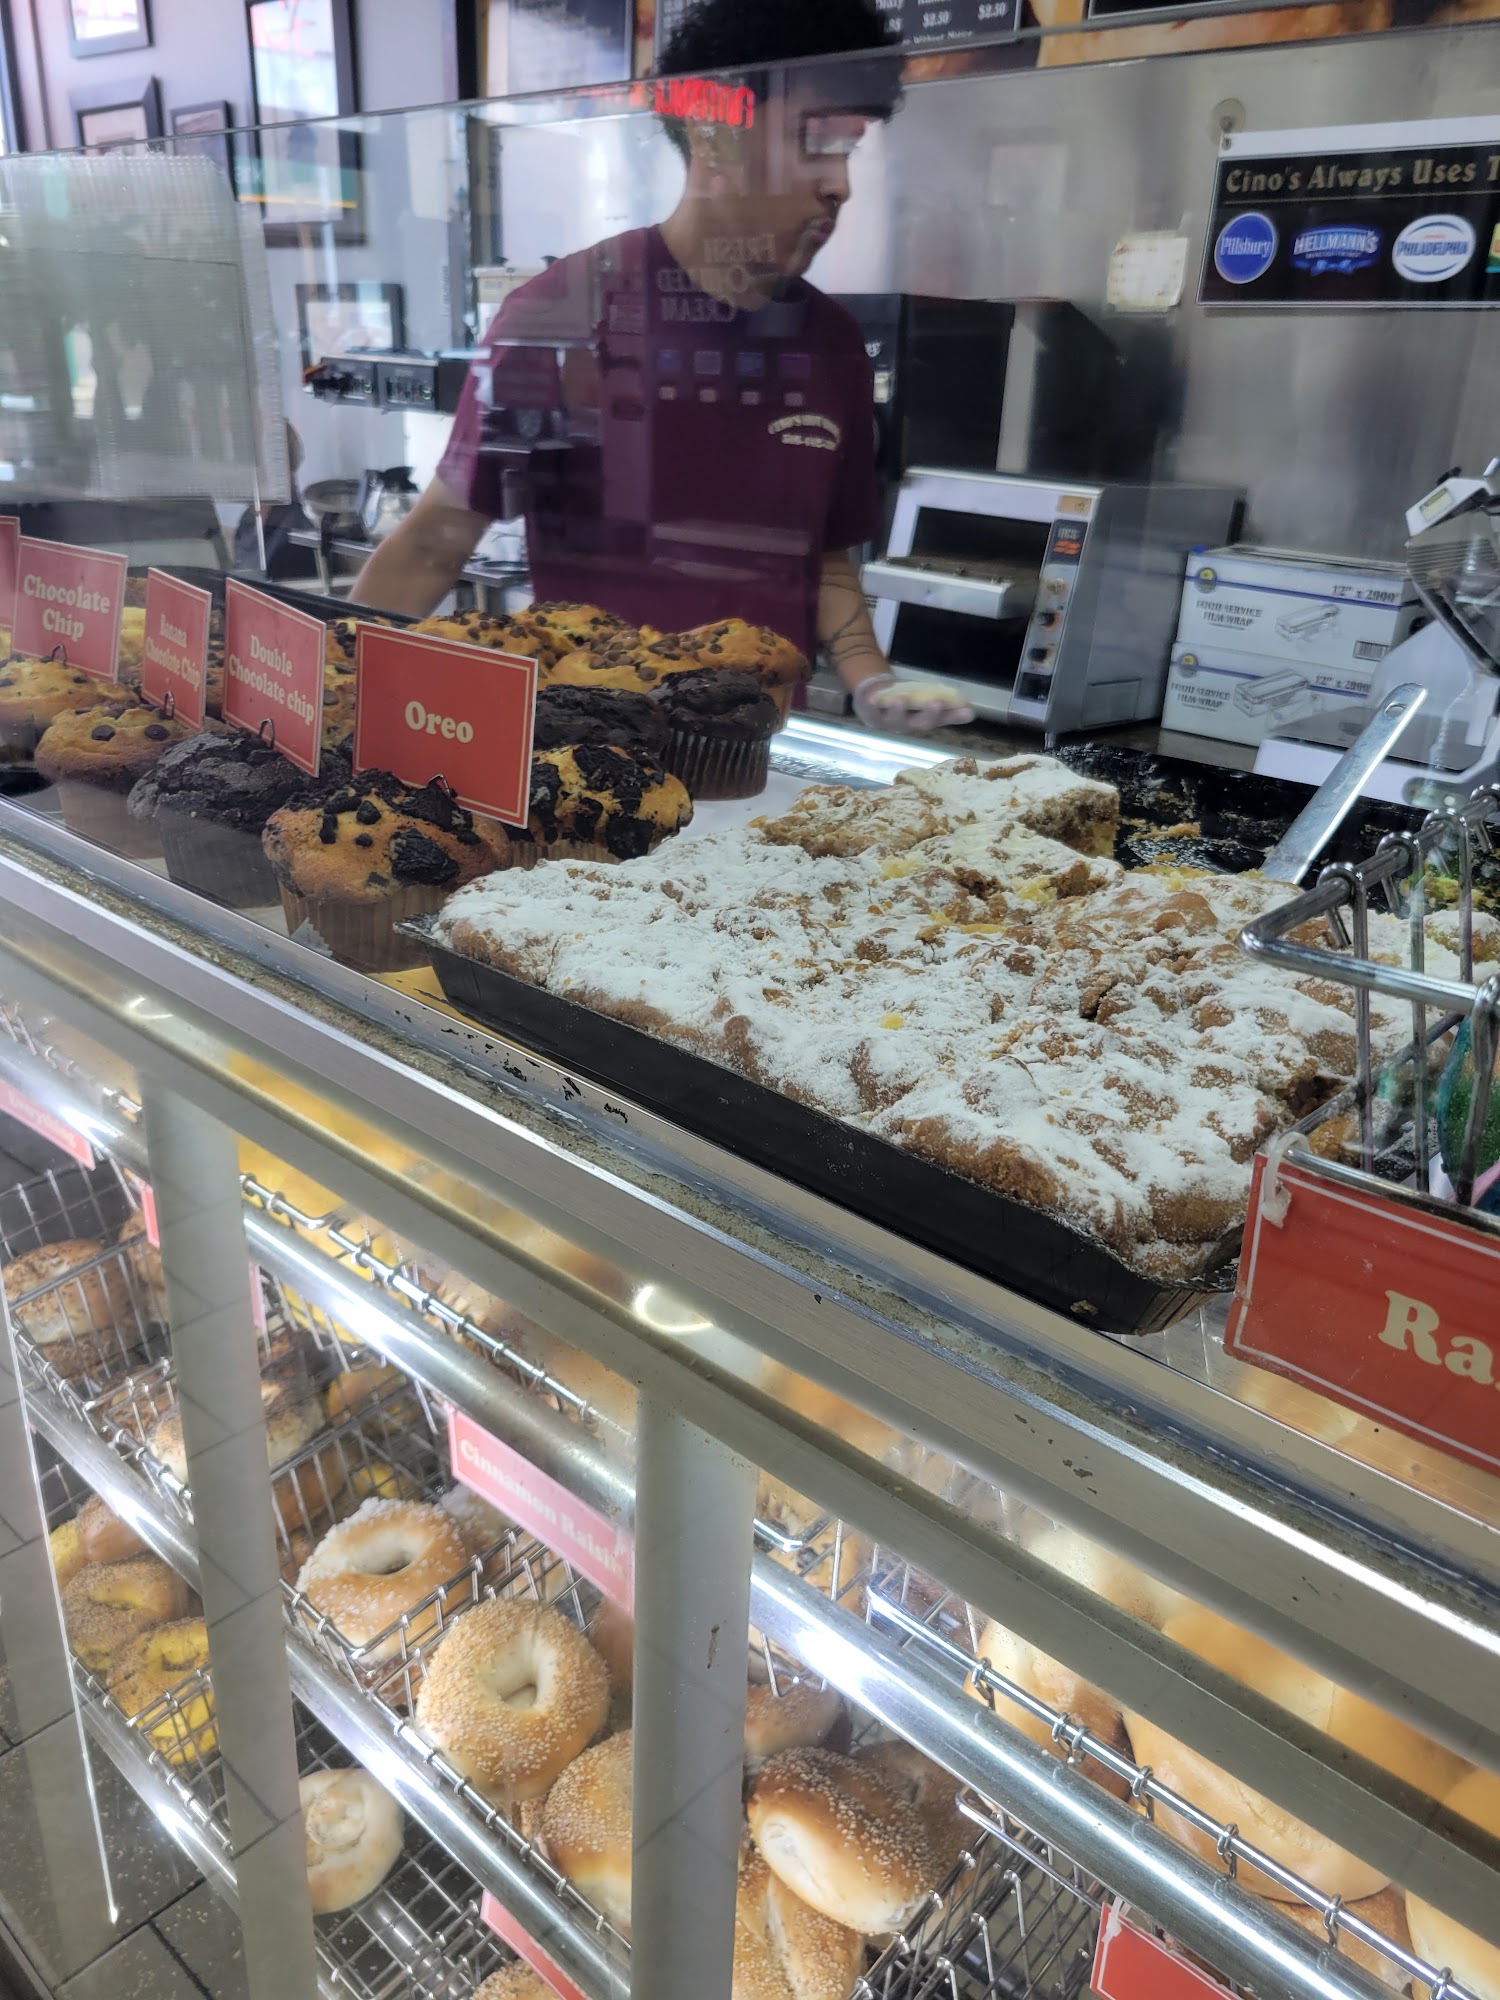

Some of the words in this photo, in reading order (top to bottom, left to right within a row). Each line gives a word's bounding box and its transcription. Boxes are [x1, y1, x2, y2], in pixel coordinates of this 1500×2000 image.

[1226, 166, 1301, 193] Cino's
[1307, 164, 1402, 192] Always
[1412, 159, 1476, 184] Uses
[1220, 236, 1273, 258] Pillsbury
[23, 573, 111, 614] Chocolate
[1196, 600, 1222, 611] FOOD
[1224, 604, 1263, 618] SERVICE
[42, 607, 85, 642] Chip
[160, 612, 187, 648] Banana
[1203, 611, 1225, 622] FILM
[1227, 615, 1255, 626] WRAP
[146, 636, 180, 676] Chocolate
[181, 656, 200, 692] Chip
[250, 634, 293, 678] Double
[228, 653, 285, 704] Chocolate
[287, 690, 314, 726] chip
[1197, 687, 1231, 700] SERVICE
[1198, 697, 1223, 707] WRAP
[404, 700, 475, 744] Oreo
[1378, 1289, 1500, 1392] Ra
[459, 1438, 557, 1525] Cinnamon
[561, 1513, 625, 1579] Raisin
